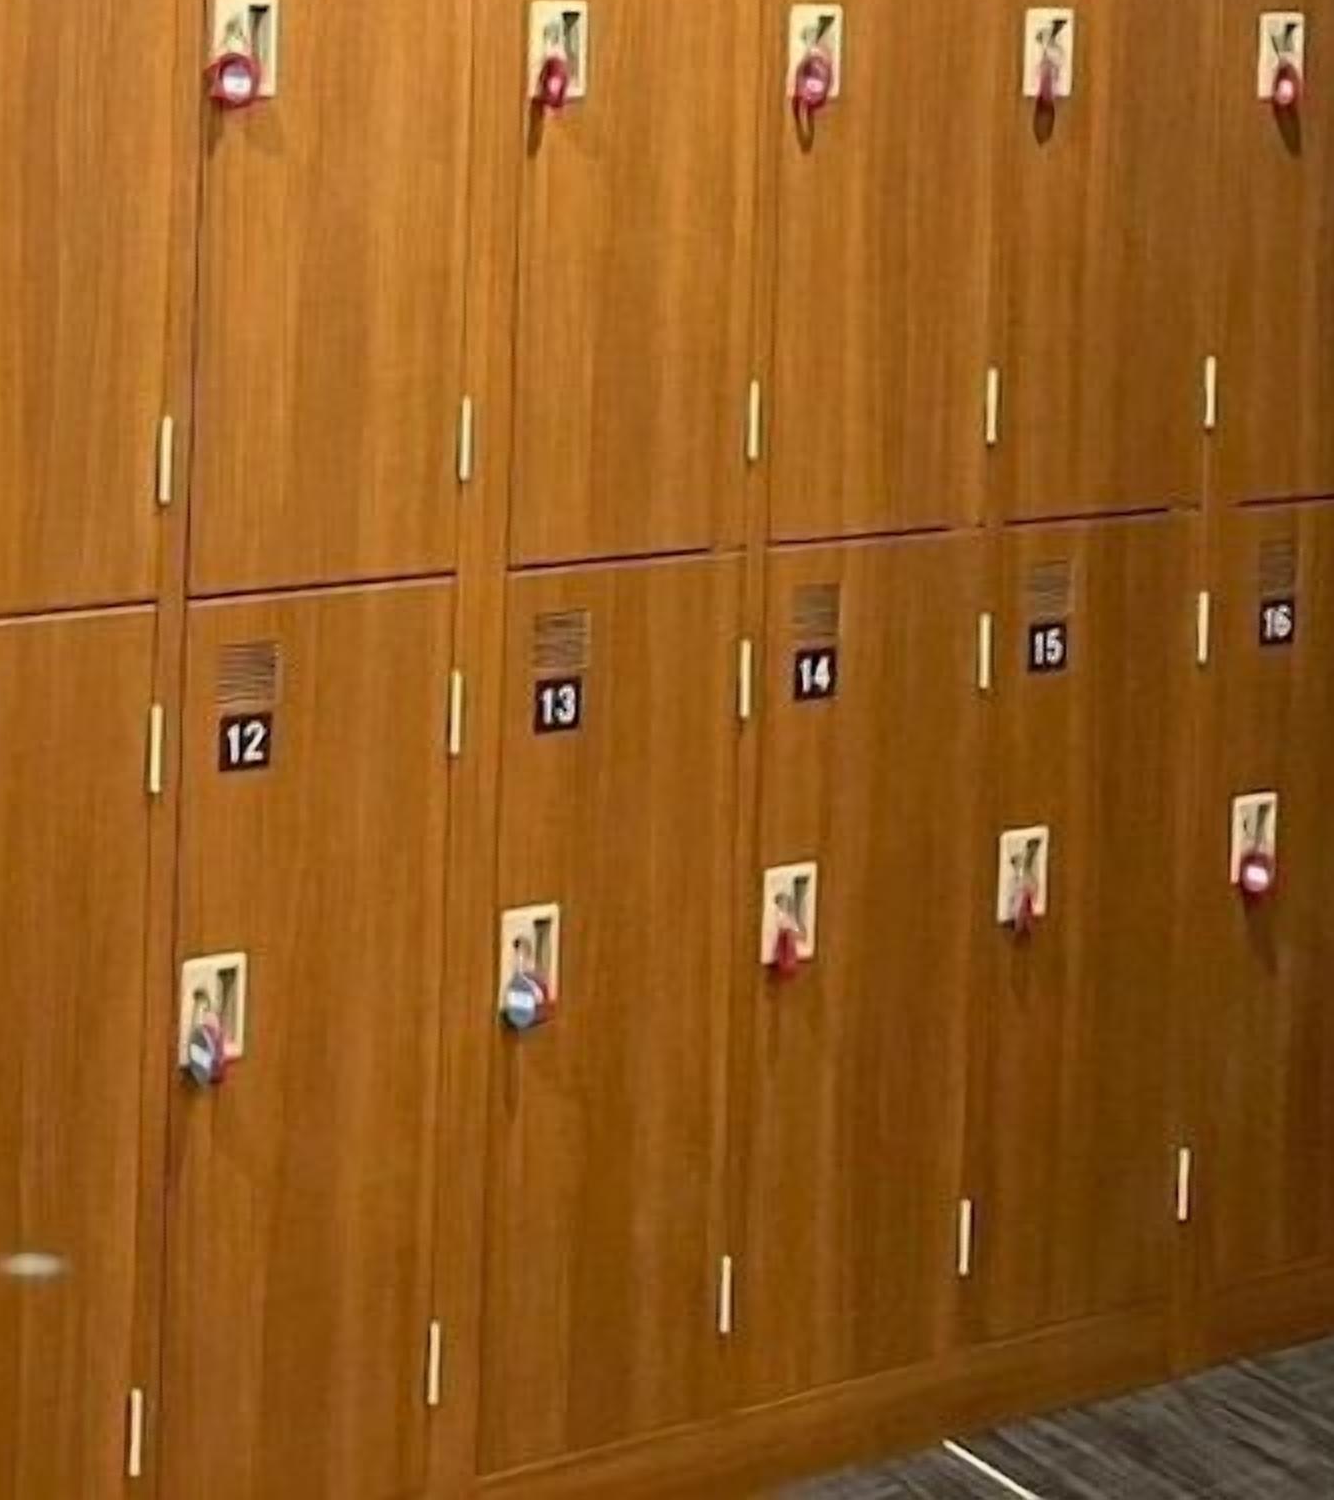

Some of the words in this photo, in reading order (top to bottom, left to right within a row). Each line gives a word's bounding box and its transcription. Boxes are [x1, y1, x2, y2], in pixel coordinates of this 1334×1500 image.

[1263, 604, 1292, 638] 16
[1034, 628, 1063, 664] 15
[799, 655, 831, 693] 14
[542, 683, 577, 725] 13
[226, 719, 265, 763] 12
